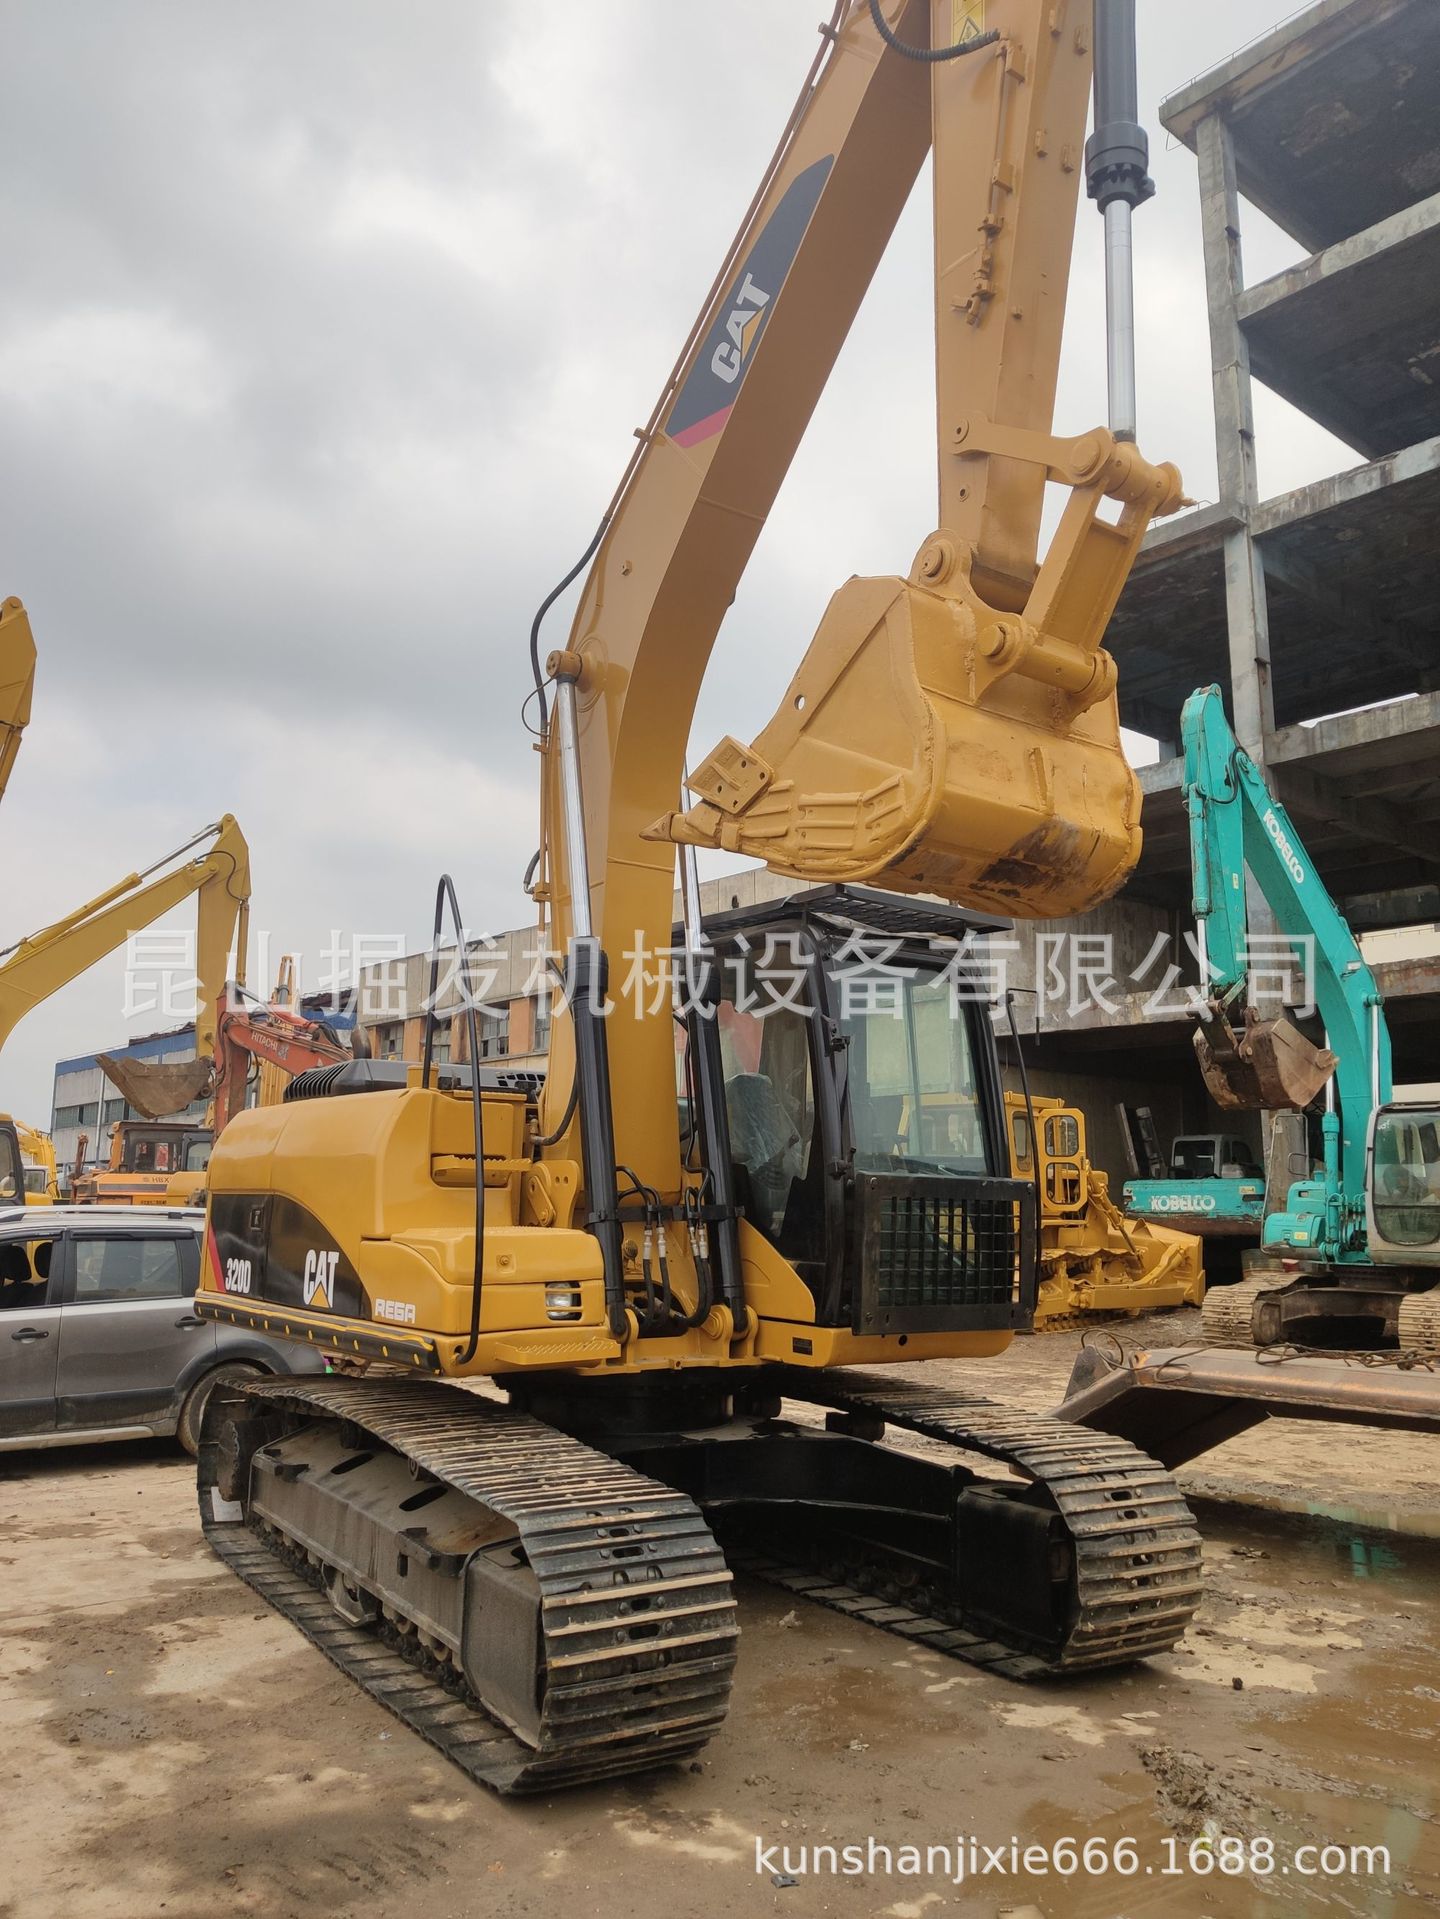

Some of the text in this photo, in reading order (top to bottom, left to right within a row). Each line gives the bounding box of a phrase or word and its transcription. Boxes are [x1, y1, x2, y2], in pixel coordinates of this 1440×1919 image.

[711, 272, 770, 384] CAT
[1263, 808, 1304, 883] KOBELCO
[251, 1030, 278, 1052] HITACHI
[1151, 1195, 1216, 1211] KOBELCO
[225, 1257, 251, 1294] 320D
[303, 1249, 340, 1309] CAT
